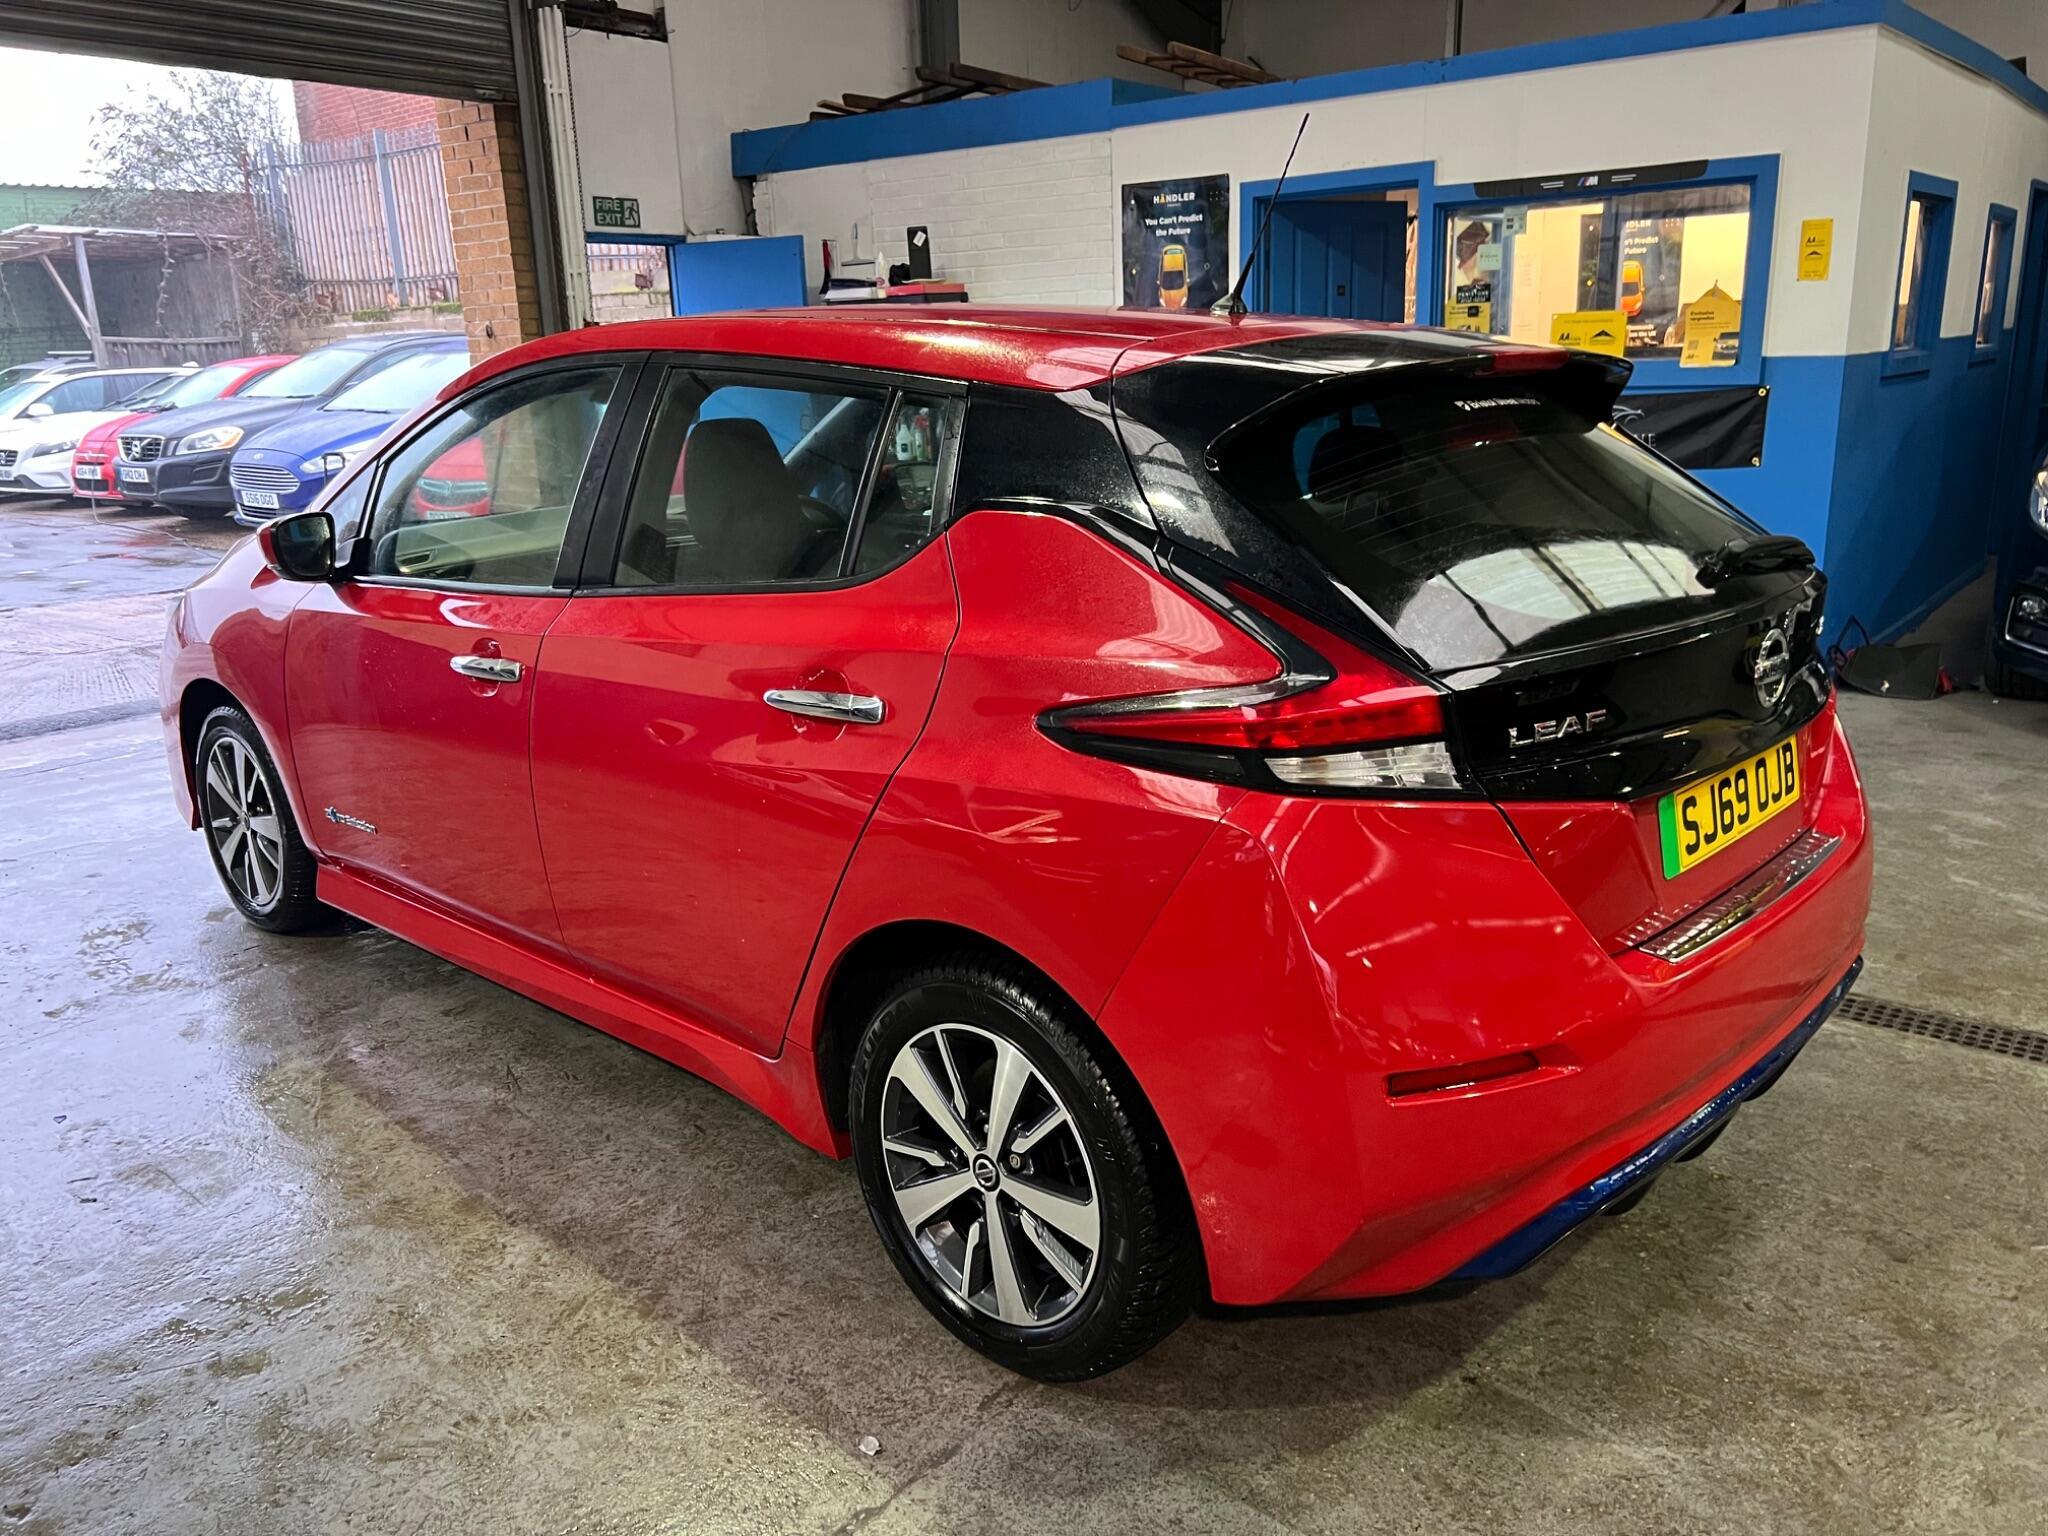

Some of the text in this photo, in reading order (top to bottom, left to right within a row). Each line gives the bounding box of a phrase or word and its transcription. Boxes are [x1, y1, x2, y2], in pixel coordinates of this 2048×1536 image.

[596, 198, 621, 211] FIRE
[597, 213, 622, 225] EXIT
[1144, 213, 1203, 226] You Can't Predict
[1155, 228, 1191, 237] the Future
[1508, 709, 1607, 748] LEAF
[1681, 741, 1795, 856] SJ69 OJB
